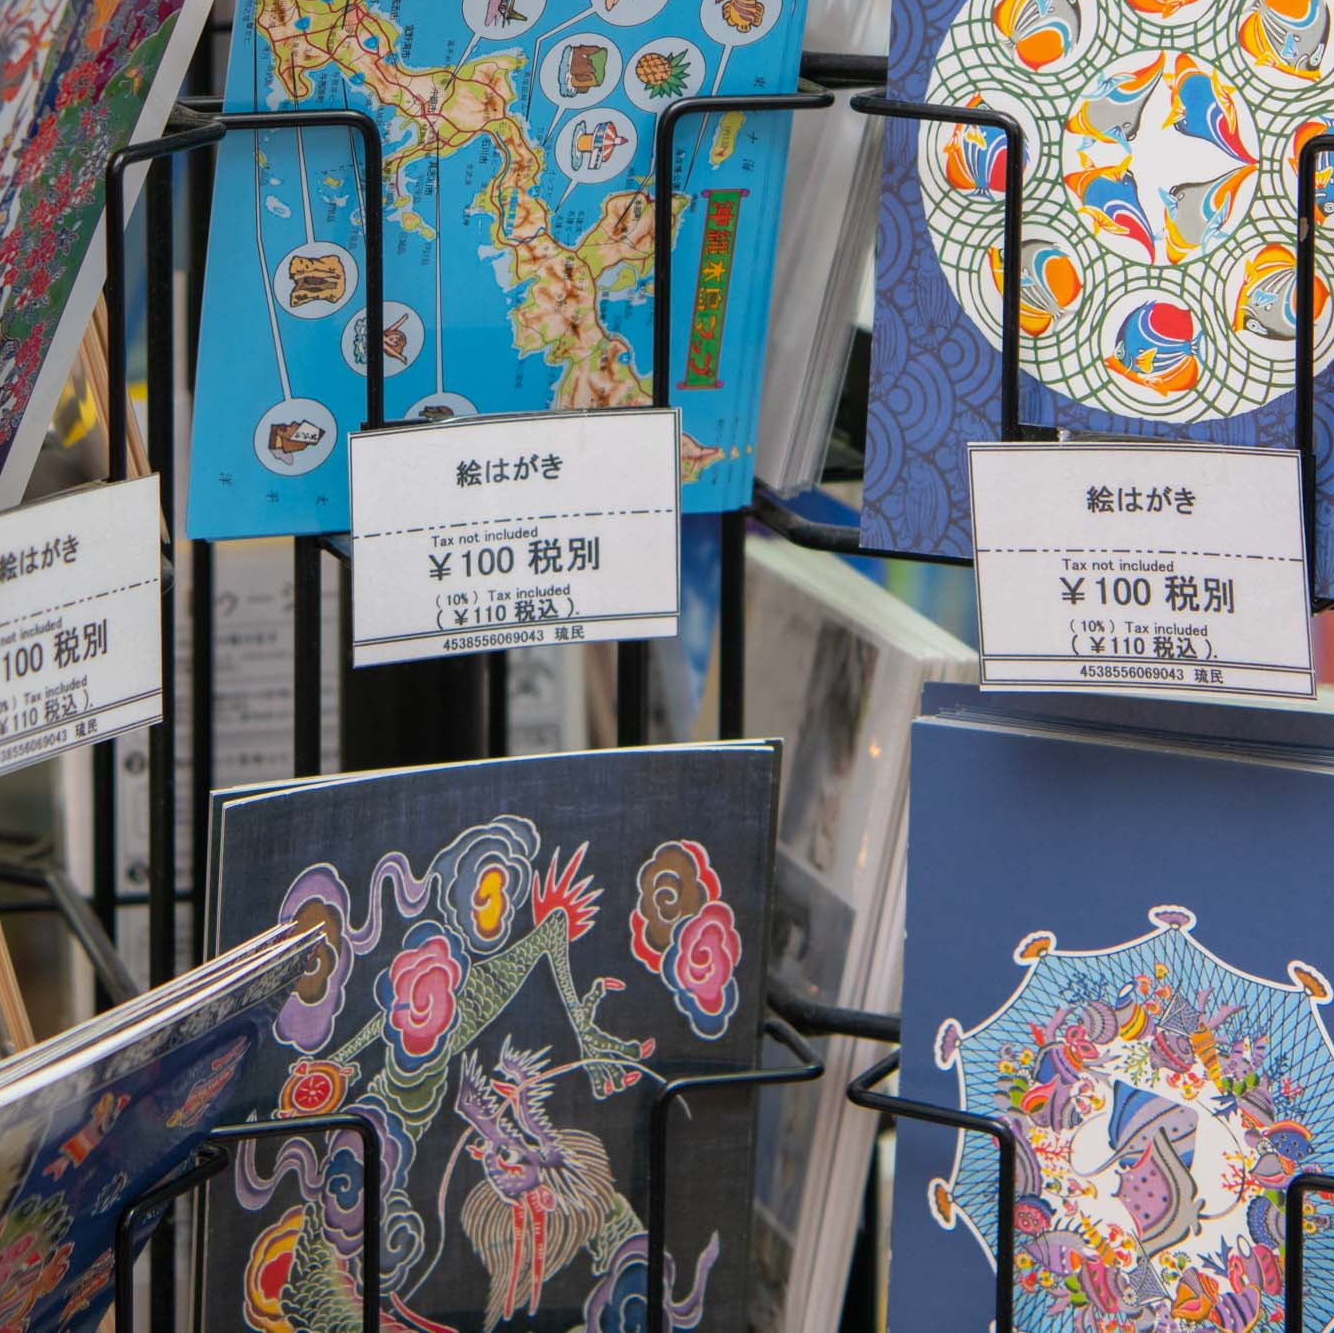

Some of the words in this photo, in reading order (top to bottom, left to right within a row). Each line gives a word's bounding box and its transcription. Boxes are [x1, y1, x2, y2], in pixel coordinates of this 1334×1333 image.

[690, 200, 735, 379] 沖縄本島マップ
[456, 453, 563, 488] 絵はがき
[1086, 485, 1197, 515] 絵はがき
[431, 535, 454, 547] Tax
[458, 532, 480, 545] not
[484, 526, 538, 542] included
[429, 545, 515, 581] ¥100
[528, 536, 600, 575] 税別
[1061, 558, 1087, 571] Tax
[1092, 559, 1114, 571] not
[1119, 559, 1174, 573] included
[488, 590, 511, 601] Tax
[516, 583, 571, 600] included
[1061, 577, 1151, 606] ¥100
[1165, 576, 1235, 614] 税別
[0, 630, 17, 646] not
[20, 617, 63, 640] included
[443, 630, 544, 651] 4538556069043
[555, 626, 585, 641] 琉民
[1124, 621, 1149, 634] Tax
[1154, 623, 1208, 637] included
[53, 618, 108, 670] 税別
[24, 689, 42, 705] Tax
[45, 674, 88, 700] included
[1080, 666, 1184, 681] 4538556069043
[1194, 668, 1224, 684] 琉民
